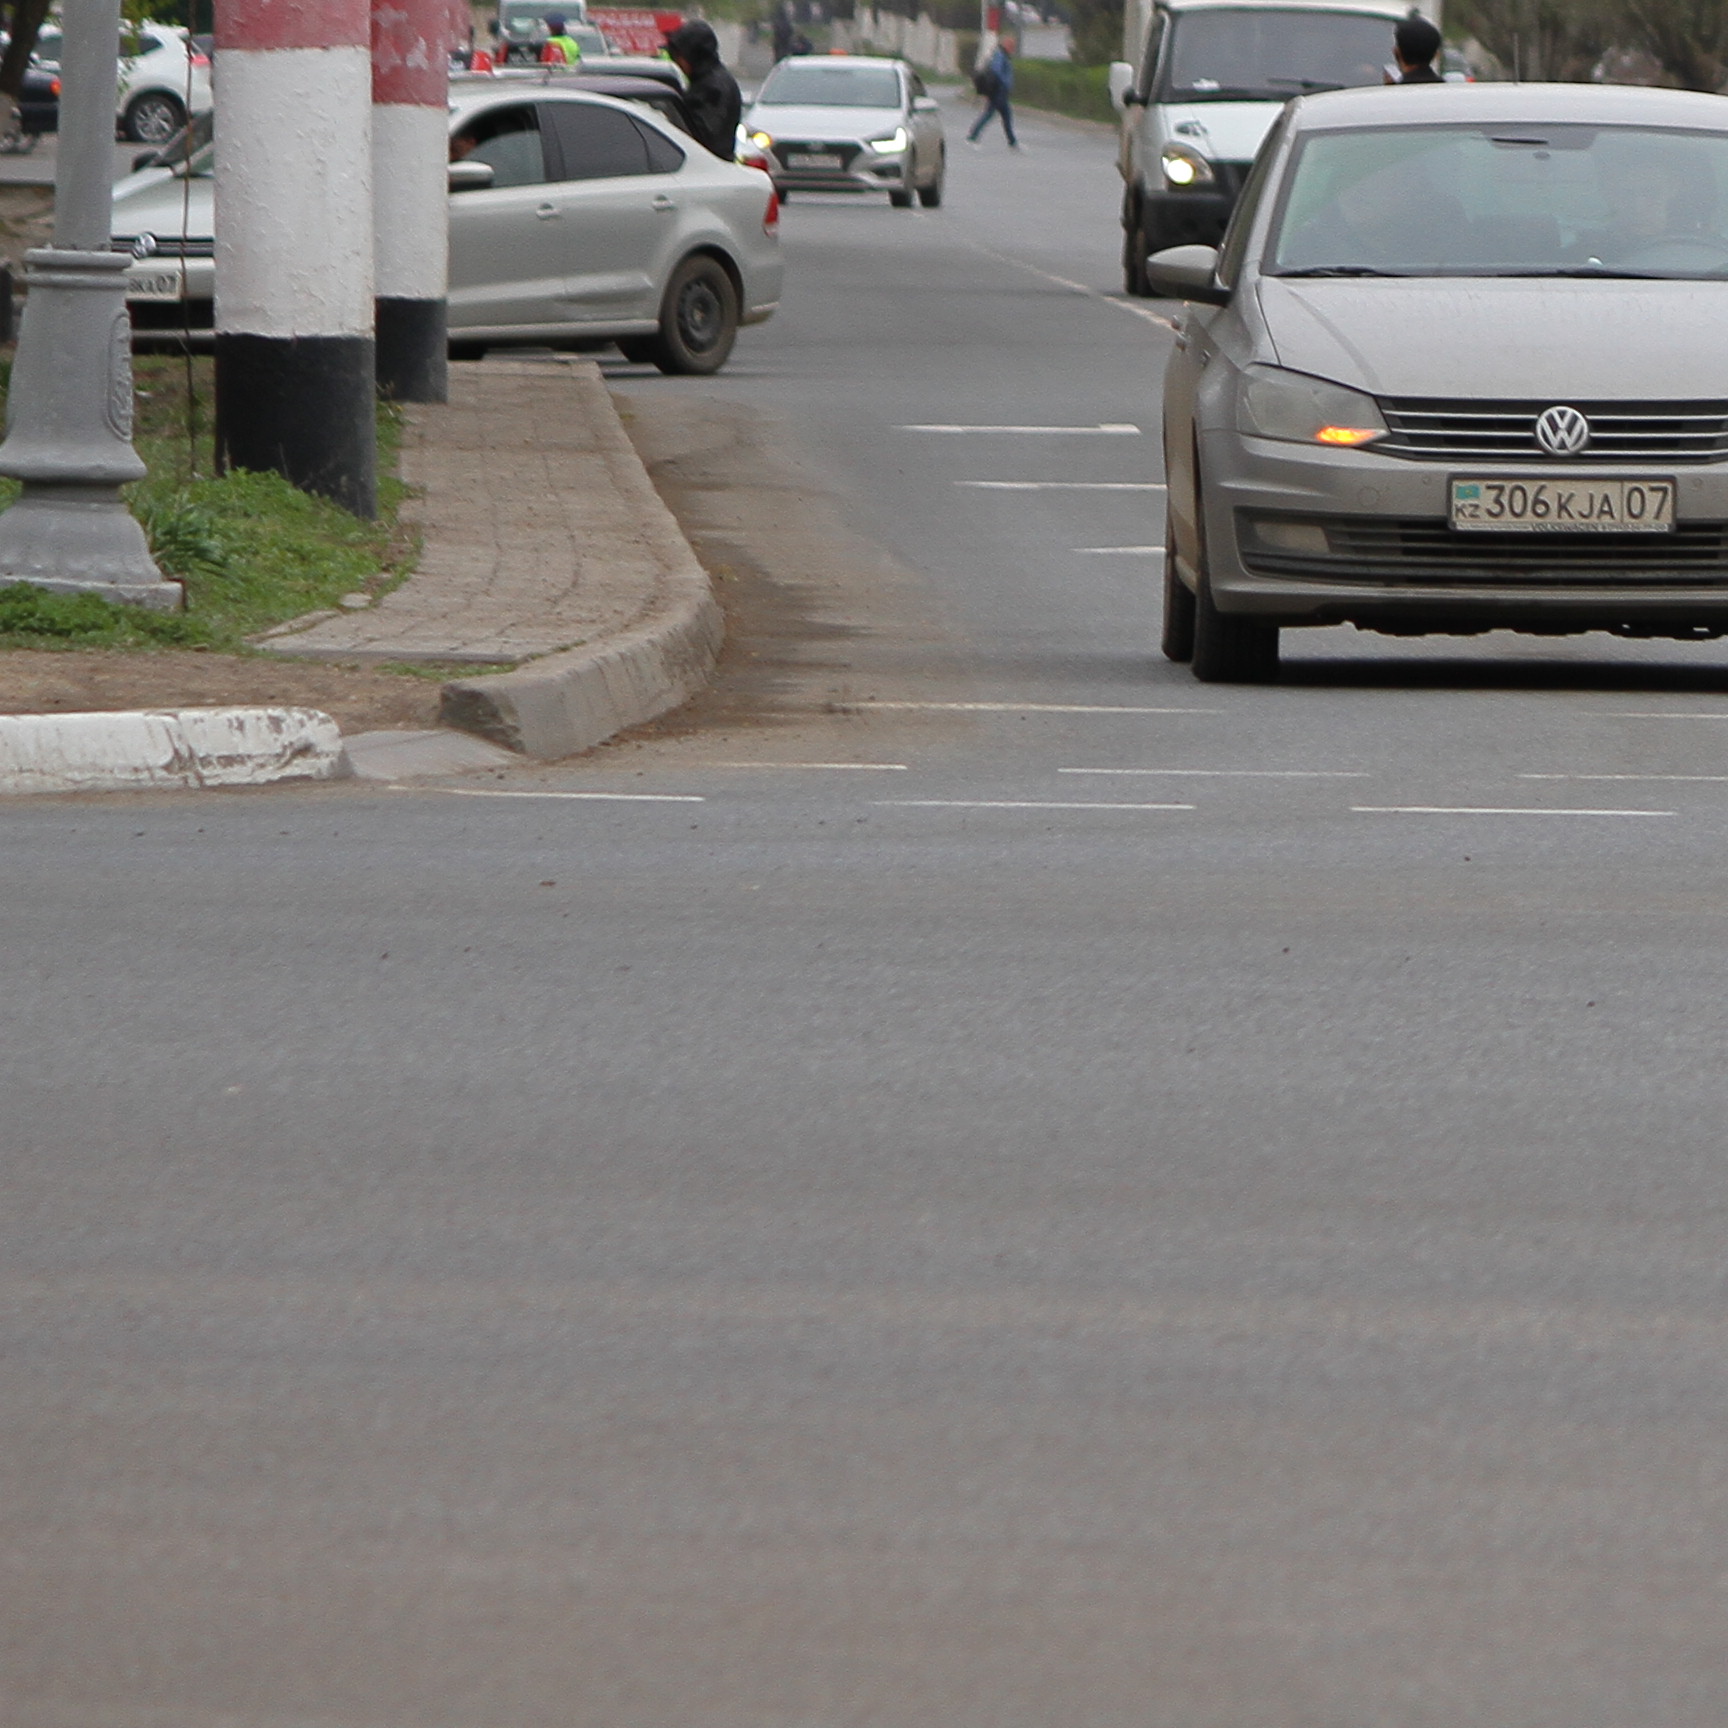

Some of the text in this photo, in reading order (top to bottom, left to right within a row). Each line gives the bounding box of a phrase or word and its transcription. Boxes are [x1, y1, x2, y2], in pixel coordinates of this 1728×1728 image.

[1454, 503, 1481, 519] KZ
[1485, 484, 1669, 520] 306KJA 07
